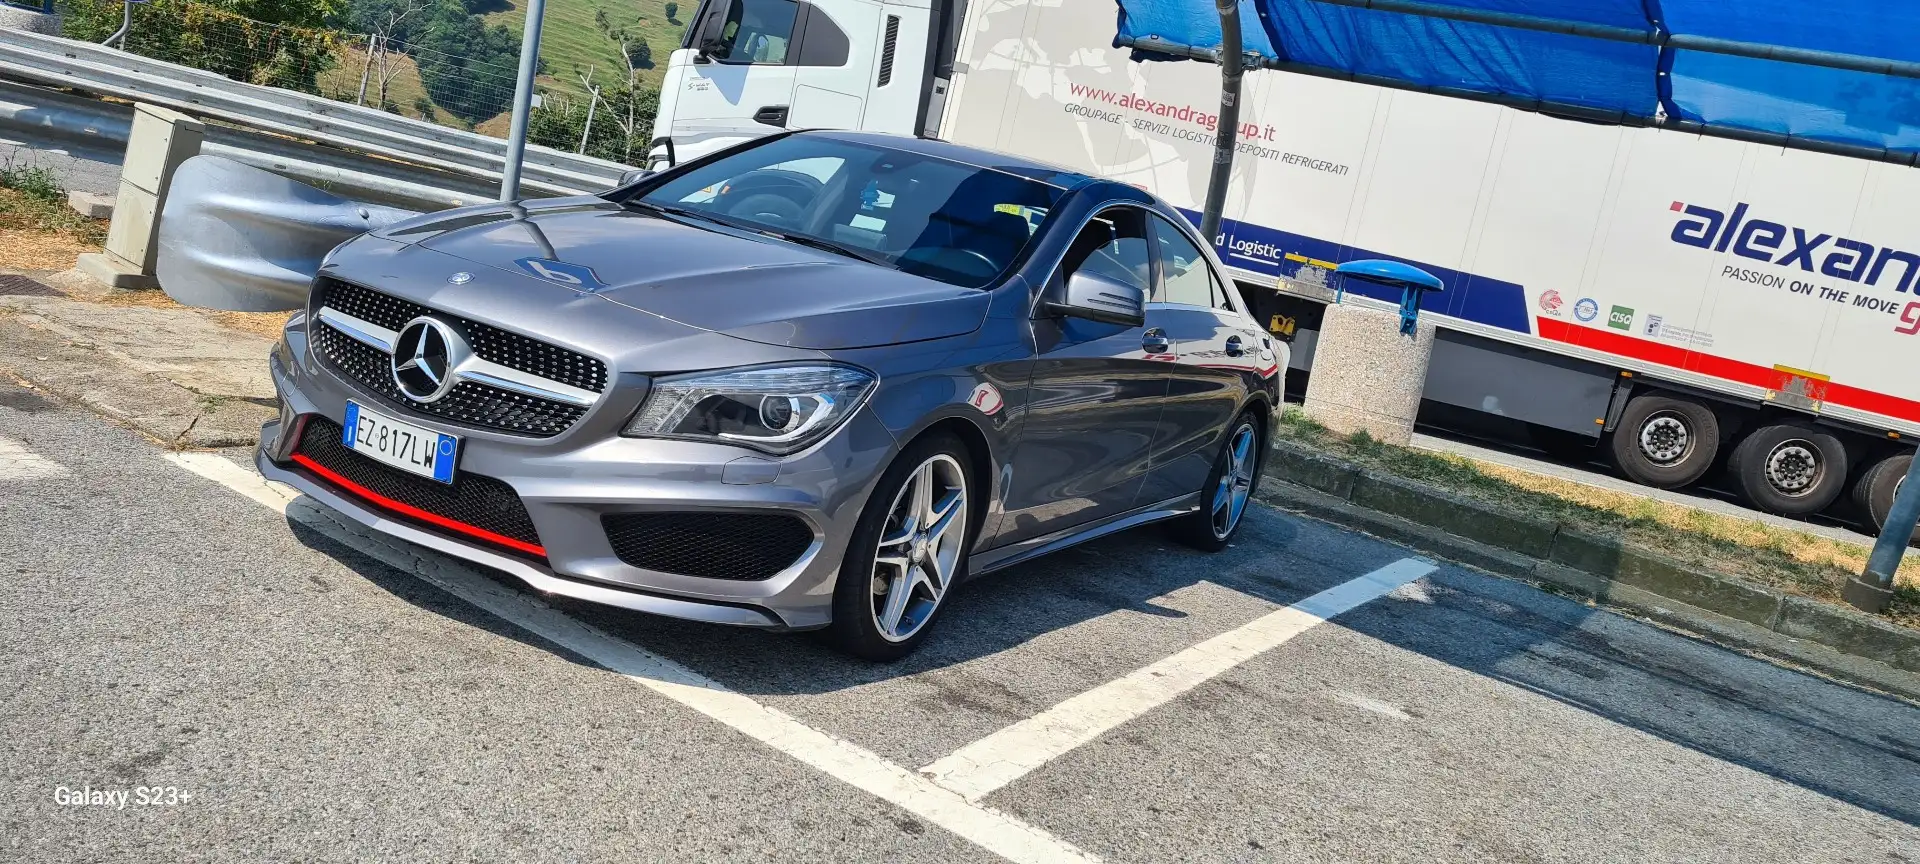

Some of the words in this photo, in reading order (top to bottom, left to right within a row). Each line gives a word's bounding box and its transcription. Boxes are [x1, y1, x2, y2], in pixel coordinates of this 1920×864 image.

[1064, 102, 1123, 125] GROUPAGE
[1132, 118, 1171, 135] SERVIZI
[1172, 127, 1218, 147] LOGISTIC
[1281, 152, 1350, 176] REFRIGERATI
[1070, 82, 1277, 142] www.alexandragup.it
[1228, 234, 1282, 259] Logistic
[1670, 201, 1920, 297] alexan
[1721, 265, 1786, 290] PASSION
[1789, 280, 1814, 296] ON
[1818, 286, 1850, 304] THE
[1852, 294, 1900, 315] MOVE
[1610, 311, 1632, 325] CISQ
